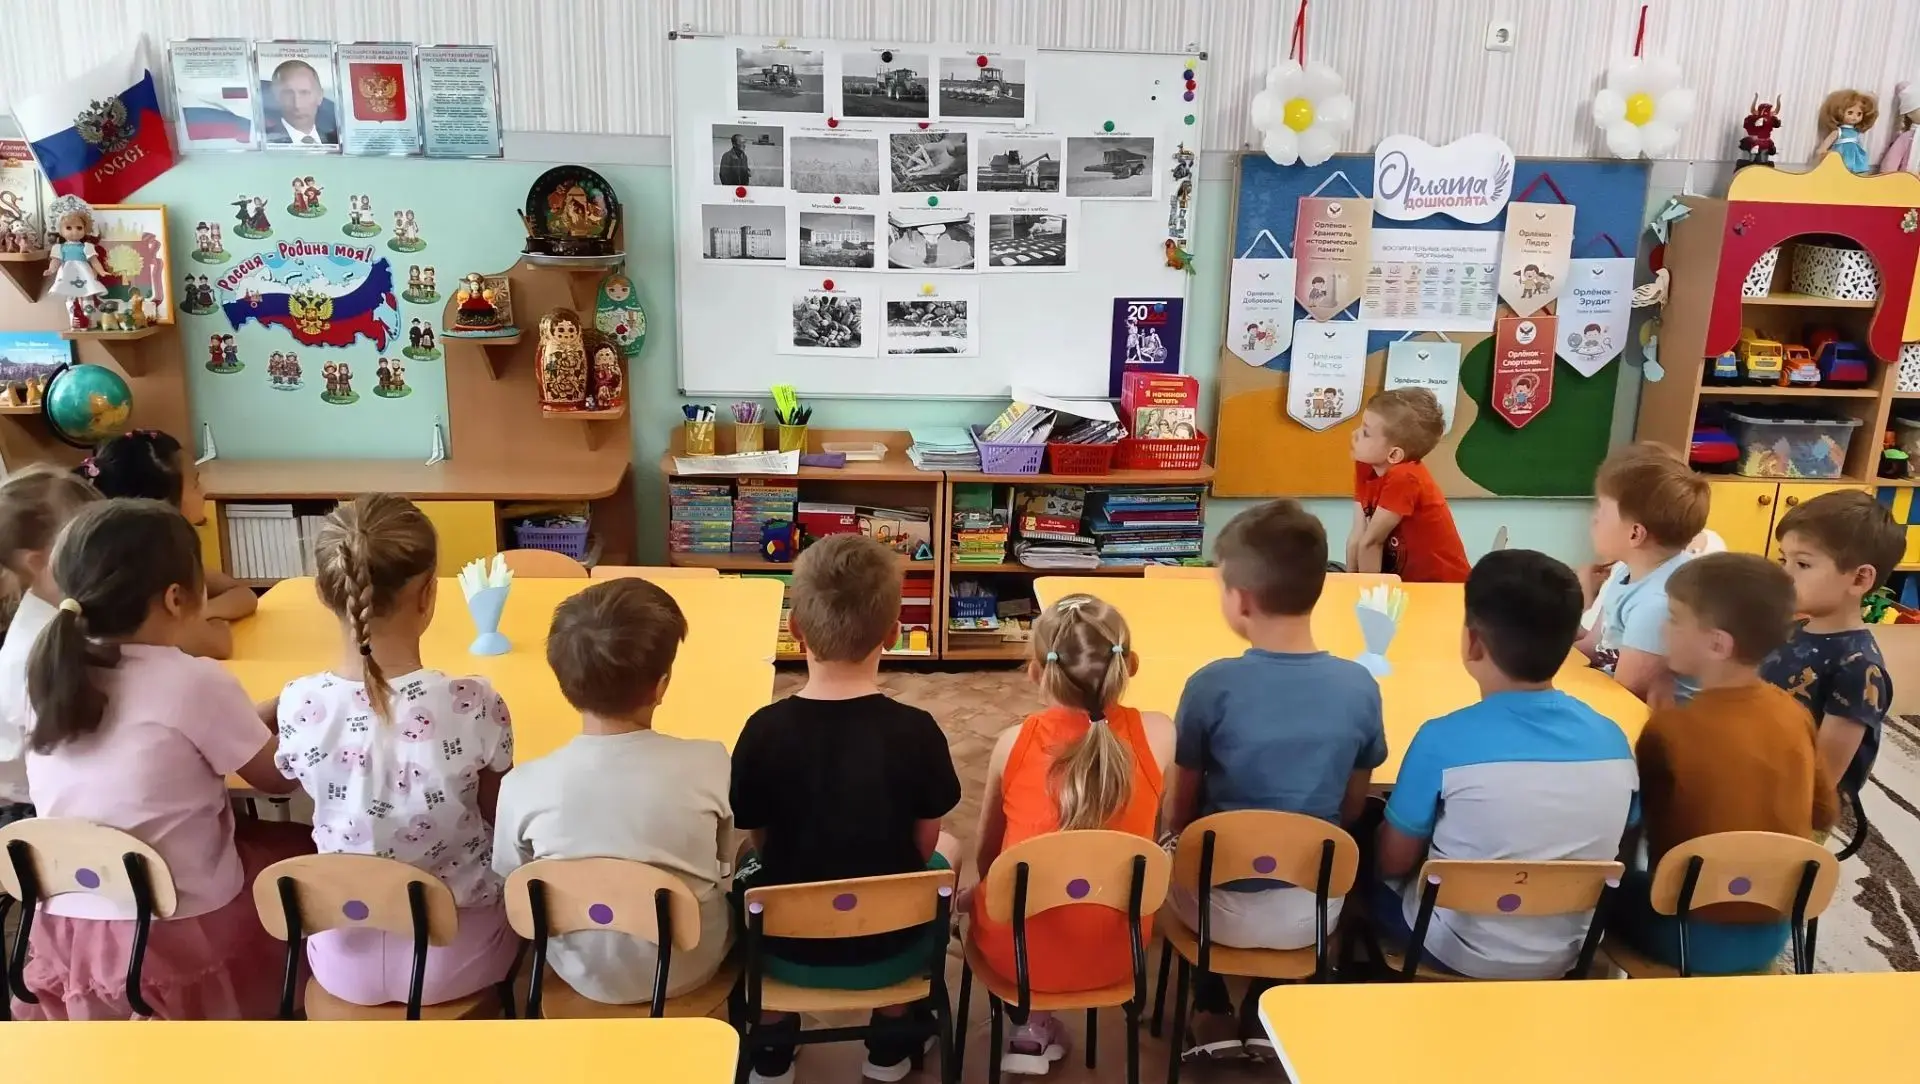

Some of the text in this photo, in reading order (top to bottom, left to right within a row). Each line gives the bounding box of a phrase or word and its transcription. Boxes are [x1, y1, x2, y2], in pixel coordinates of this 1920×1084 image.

[1378, 150, 1488, 204] Орлята
[1405, 196, 1488, 210] ДОШКОЛЯТА
[1525, 238, 1550, 247] Лидер
[217, 256, 264, 291] Россия
[278, 239, 329, 259] Родина
[335, 246, 373, 262] моя!
[1573, 288, 1611, 297] Орлёнок
[1579, 297, 1611, 306] Эрудит
[1502, 359, 1542, 367] Спортсмен
[1514, 871, 1529, 885] 2
